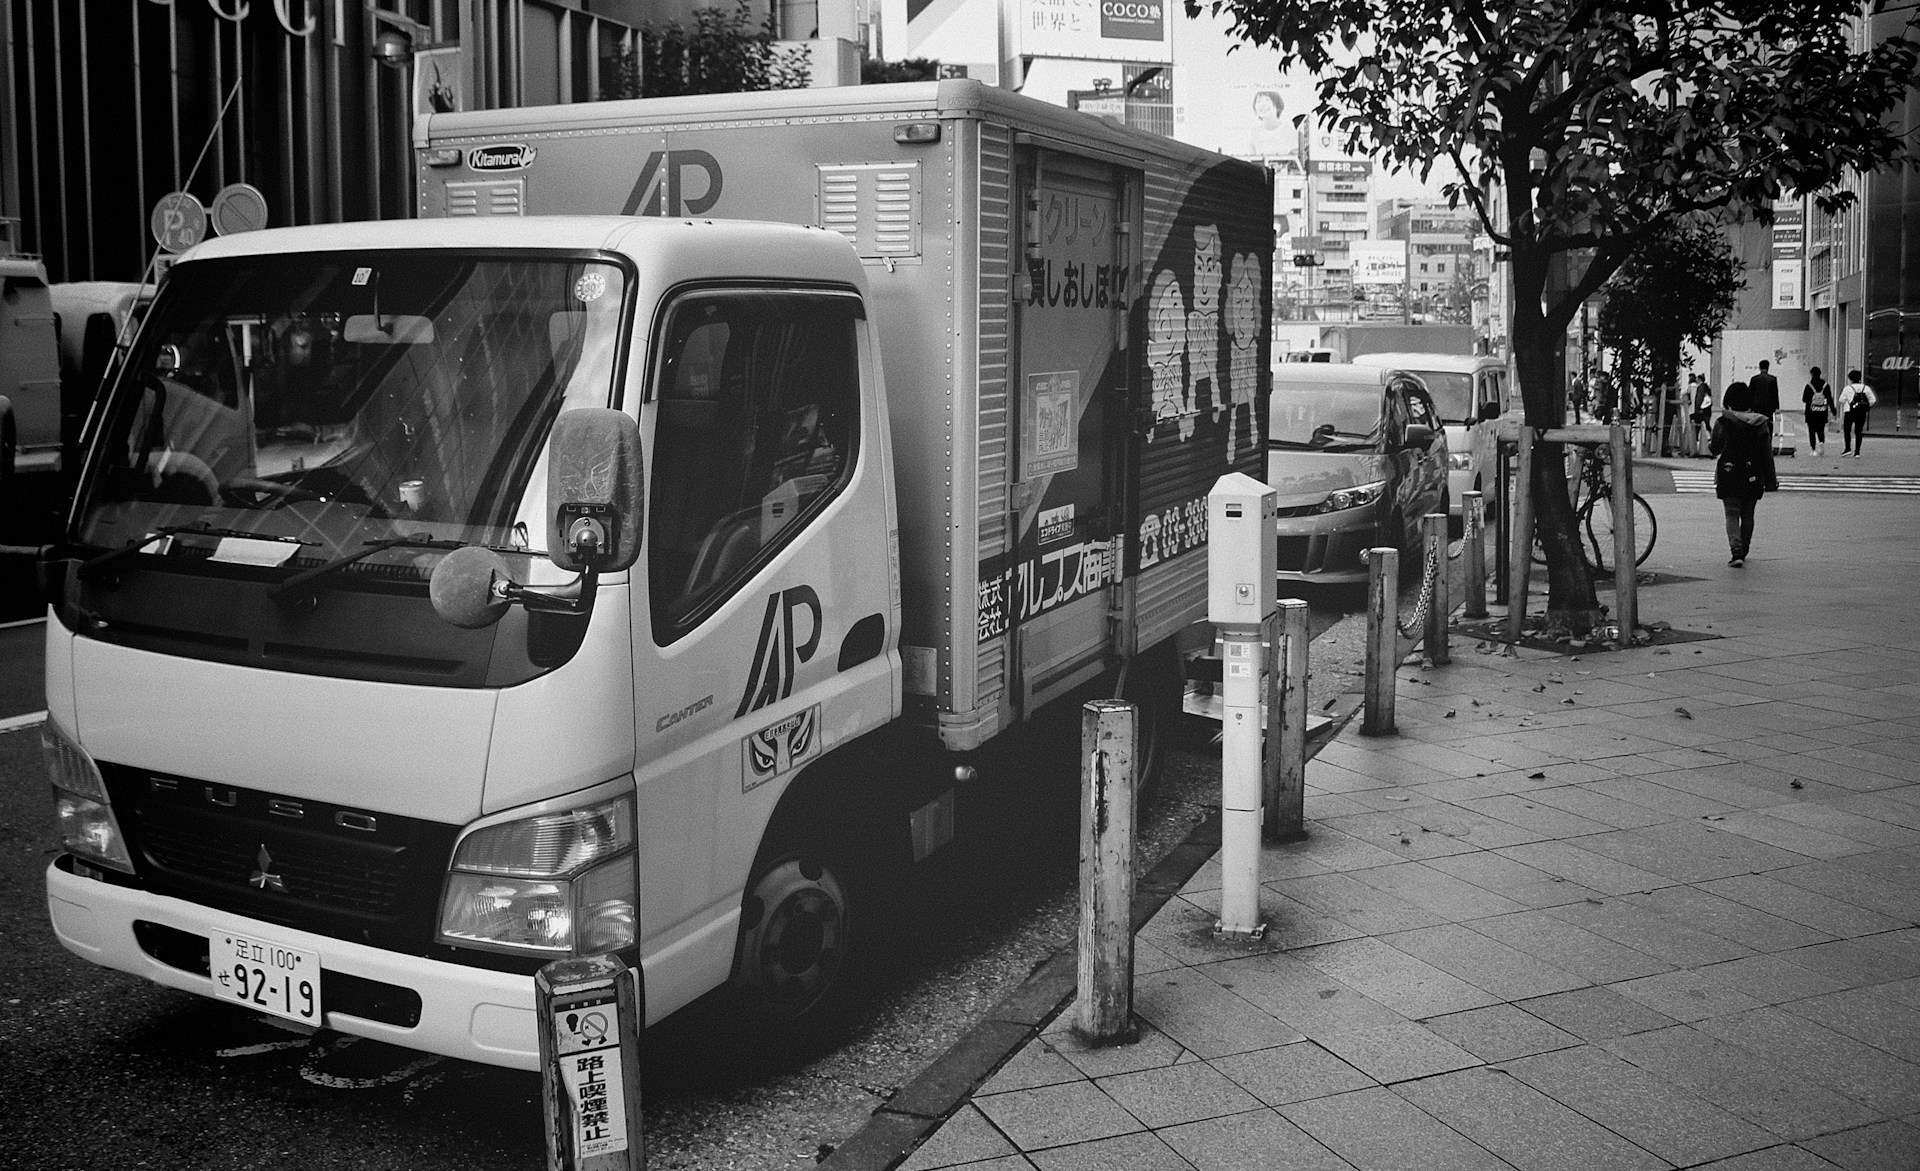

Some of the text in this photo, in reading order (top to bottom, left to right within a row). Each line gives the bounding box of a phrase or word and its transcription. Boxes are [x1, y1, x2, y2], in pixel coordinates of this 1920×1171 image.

[471, 150, 519, 168] Kitamura
[1045, 193, 1107, 247] クリーン
[1882, 356, 1914, 370] au
[656, 694, 714, 733] CANTER
[234, 963, 314, 1018] 92-19
[576, 1055, 611, 1142] 路上喫煙禁止
